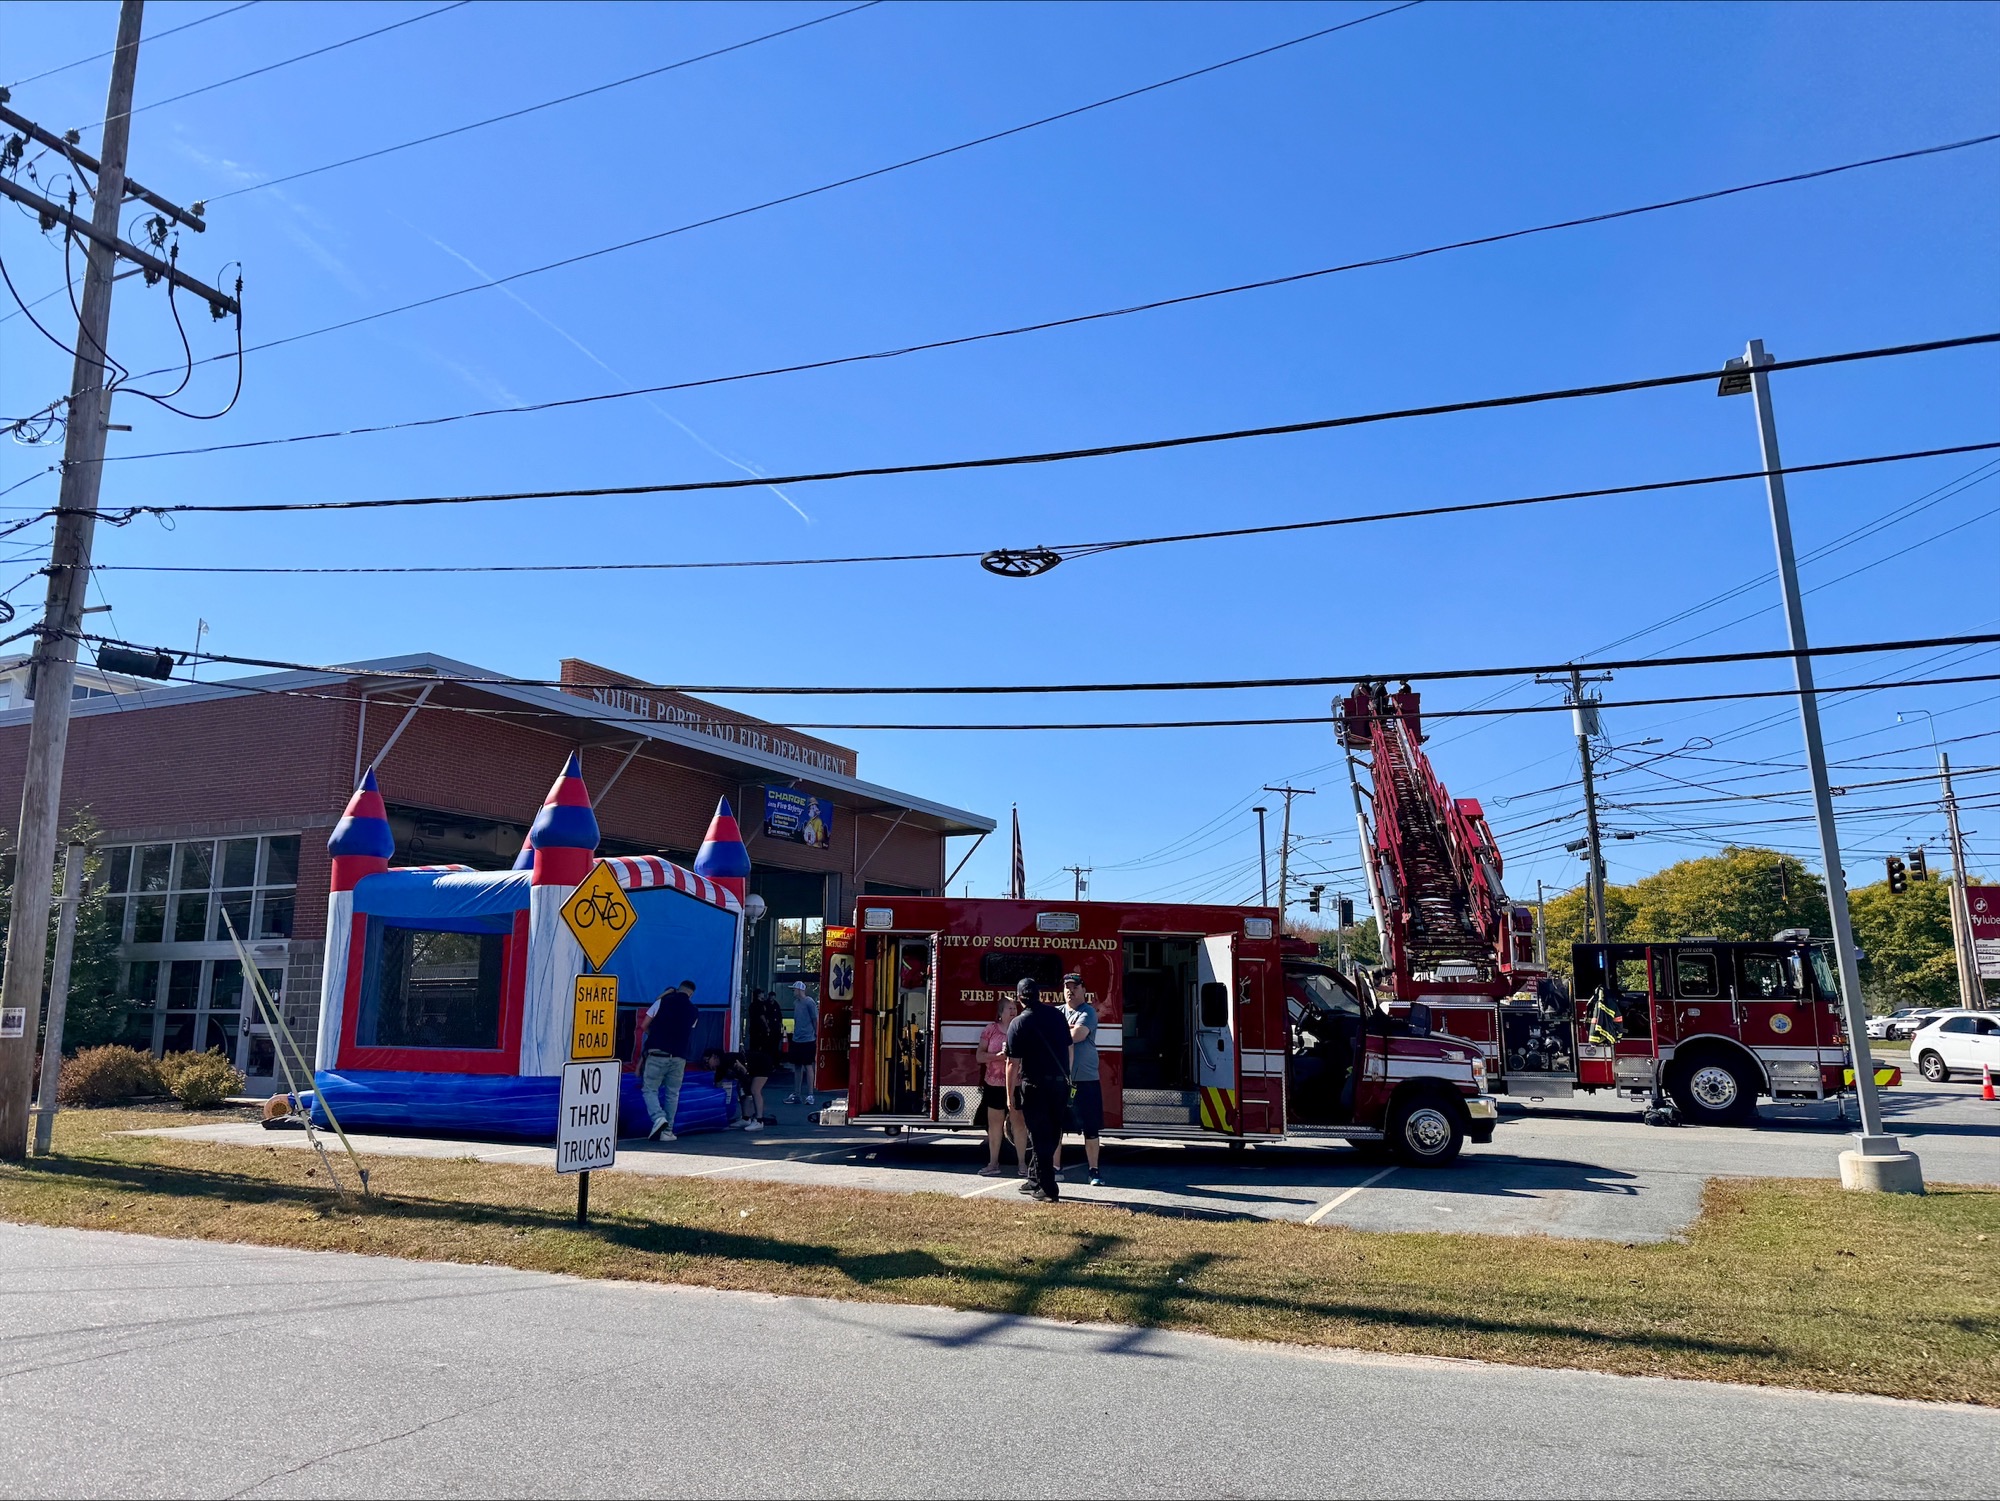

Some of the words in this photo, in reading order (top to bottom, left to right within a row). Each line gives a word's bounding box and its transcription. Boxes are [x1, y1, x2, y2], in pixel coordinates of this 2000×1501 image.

[592, 687, 650, 720] SOUTH
[656, 701, 735, 742] PORTLAND
[740, 727, 769, 752] FIRE
[772, 738, 847, 776] DEPARTMENT
[768, 790, 807, 806] CHARGE
[776, 802, 788, 810] Fire
[944, 936, 970, 947] ITY
[972, 936, 990, 947] OF
[994, 936, 1040, 948] SOUTH
[1043, 937, 1118, 950] PORTLAND
[578, 986, 614, 1002] SHARE
[960, 990, 994, 1002] FIRE
[585, 1010, 605, 1024] THE
[578, 1032, 608, 1048] ROAD
[580, 1068, 602, 1094] NO
[570, 1102, 610, 1128] THRU
[564, 1136, 610, 1164] TRUCKS
